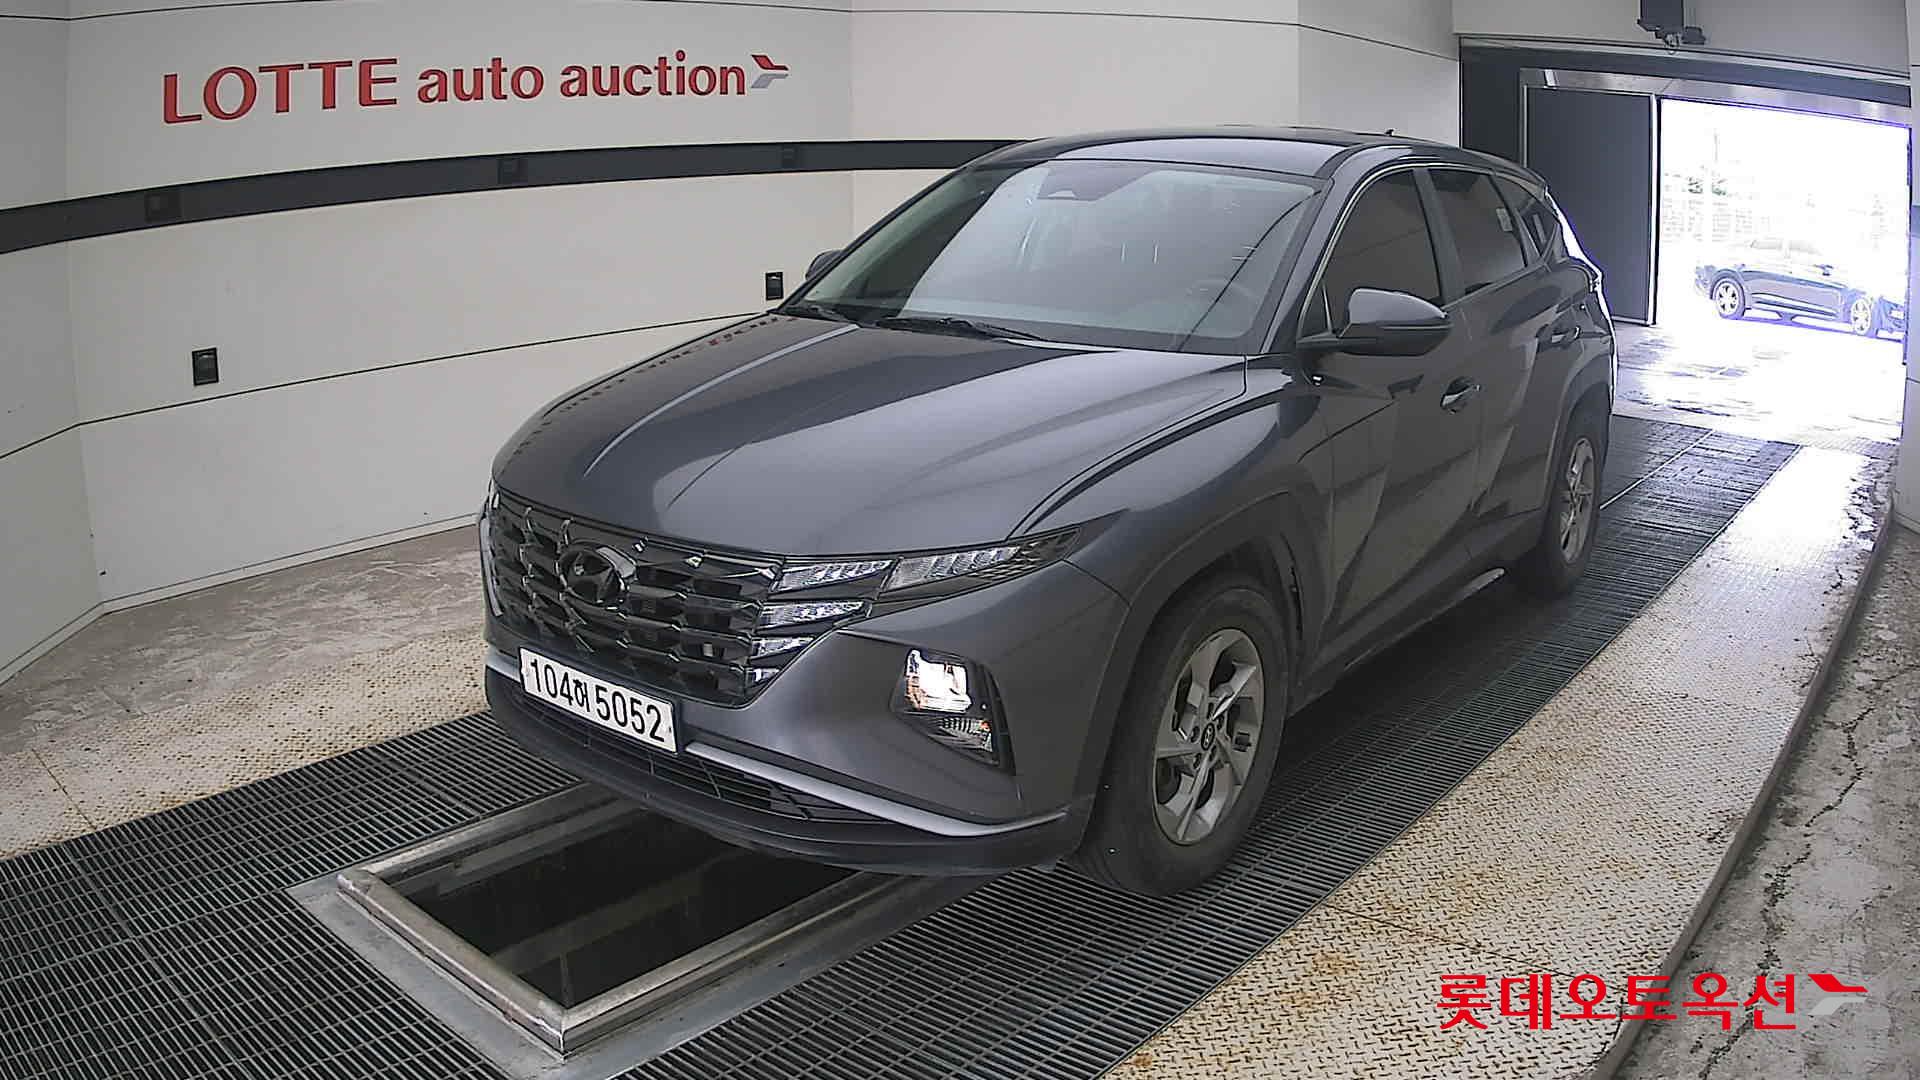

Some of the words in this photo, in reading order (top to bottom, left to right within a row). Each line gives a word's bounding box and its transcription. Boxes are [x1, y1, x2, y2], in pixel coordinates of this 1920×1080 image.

[163, 58, 398, 124] LOTTE
[417, 57, 544, 102] auto
[559, 49, 746, 96] auction
